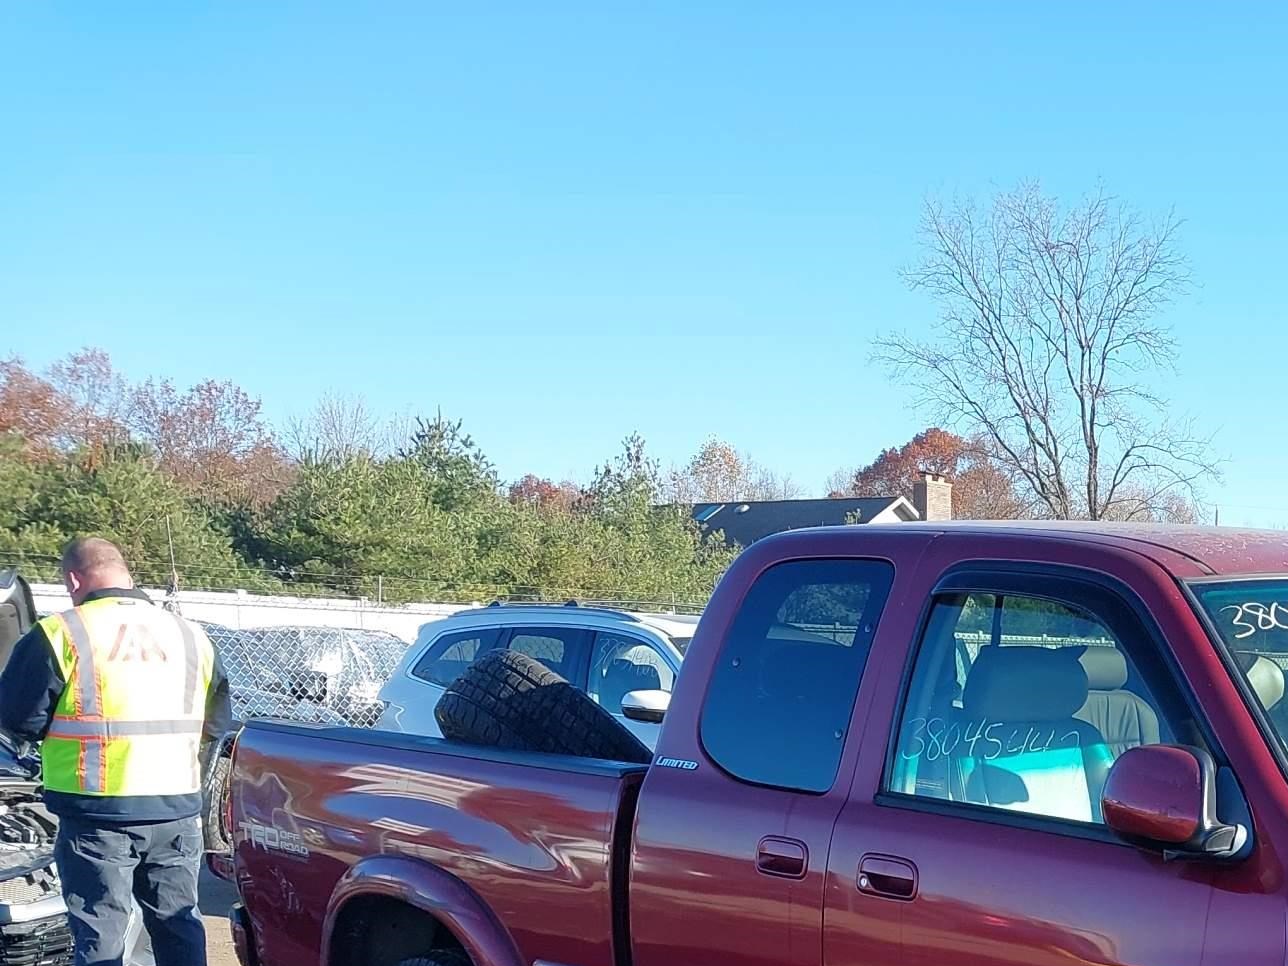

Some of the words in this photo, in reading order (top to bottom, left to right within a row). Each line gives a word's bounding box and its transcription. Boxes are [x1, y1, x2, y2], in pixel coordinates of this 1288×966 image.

[239, 821, 280, 852] TRD
[280, 830, 301, 842] OFF
[280, 840, 309, 856] ROAD
